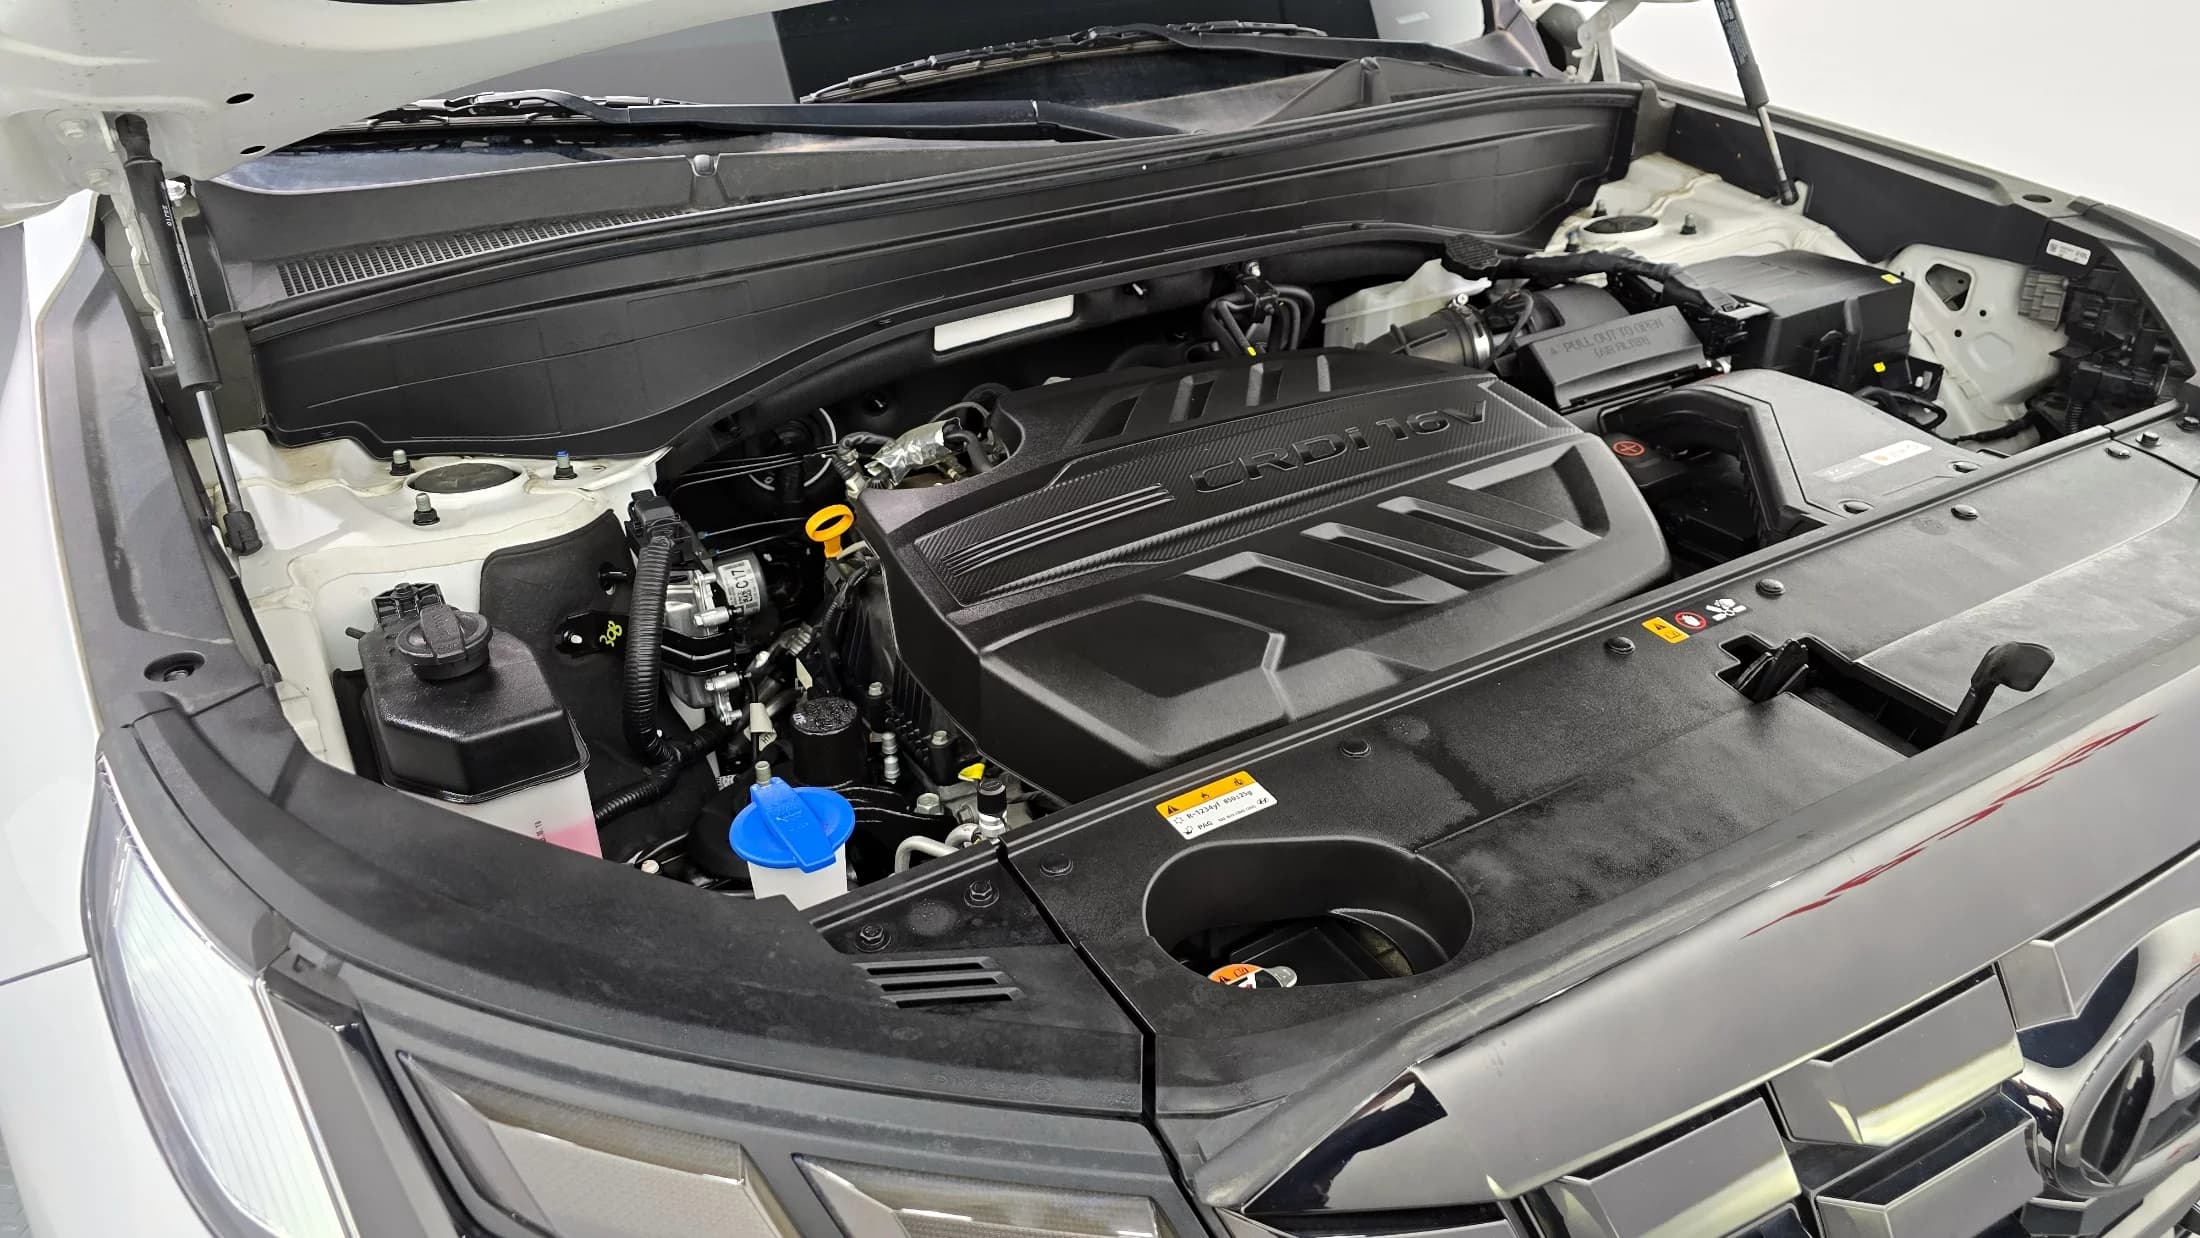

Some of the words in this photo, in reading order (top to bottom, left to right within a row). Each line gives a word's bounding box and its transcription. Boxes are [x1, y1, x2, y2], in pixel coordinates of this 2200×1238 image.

[1562, 336, 1594, 352] PULL
[1593, 329, 1617, 344] OUT
[1617, 325, 1634, 338] TO
[1190, 426, 1371, 493] CRDi
[1375, 399, 1488, 441] 16V
[730, 569, 750, 589] C17
[599, 619, 623, 648] 308
[1186, 801, 1220, 819] R-1234yf
